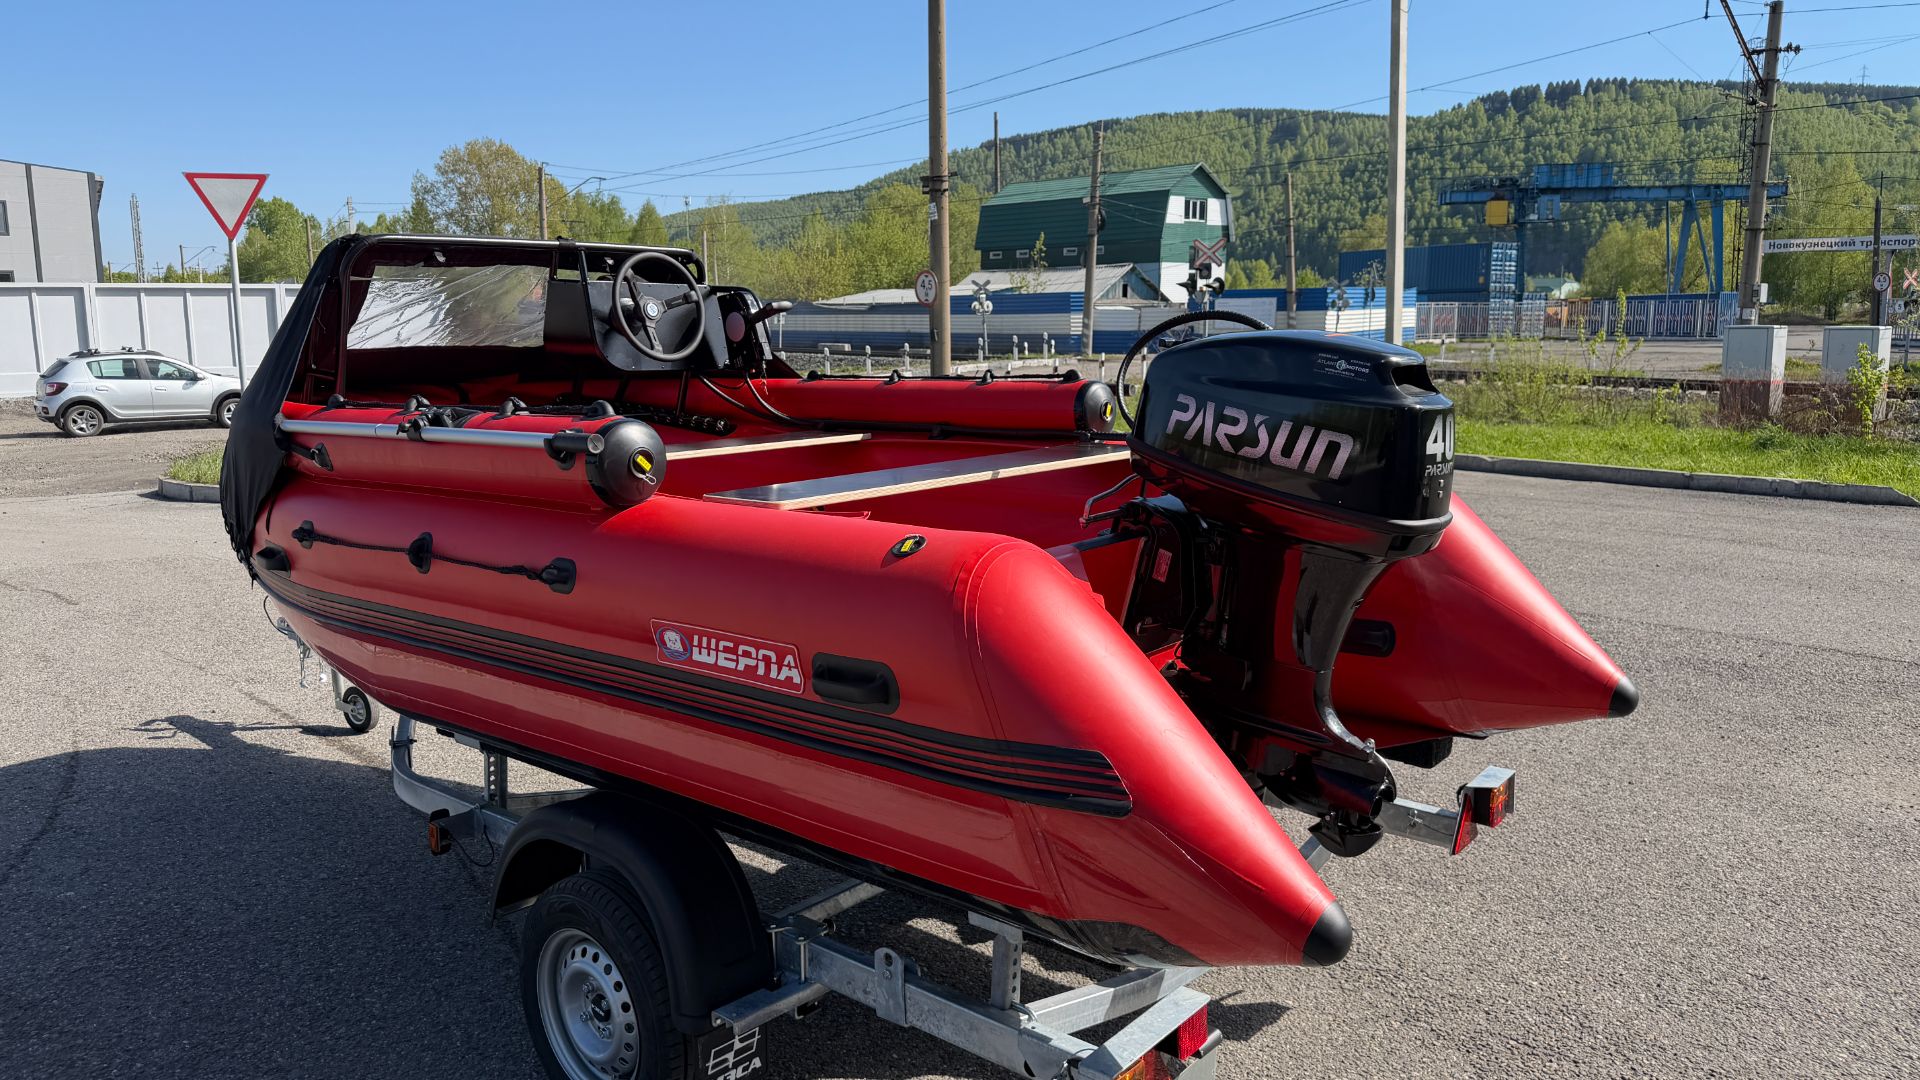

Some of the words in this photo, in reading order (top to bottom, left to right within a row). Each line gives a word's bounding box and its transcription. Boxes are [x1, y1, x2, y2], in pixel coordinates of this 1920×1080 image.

[1768, 238, 1857, 251] Новокузнецкий
[1165, 392, 1354, 480] PARSUN
[1425, 412, 1454, 463] 40
[691, 634, 801, 685] ШЕРПА
